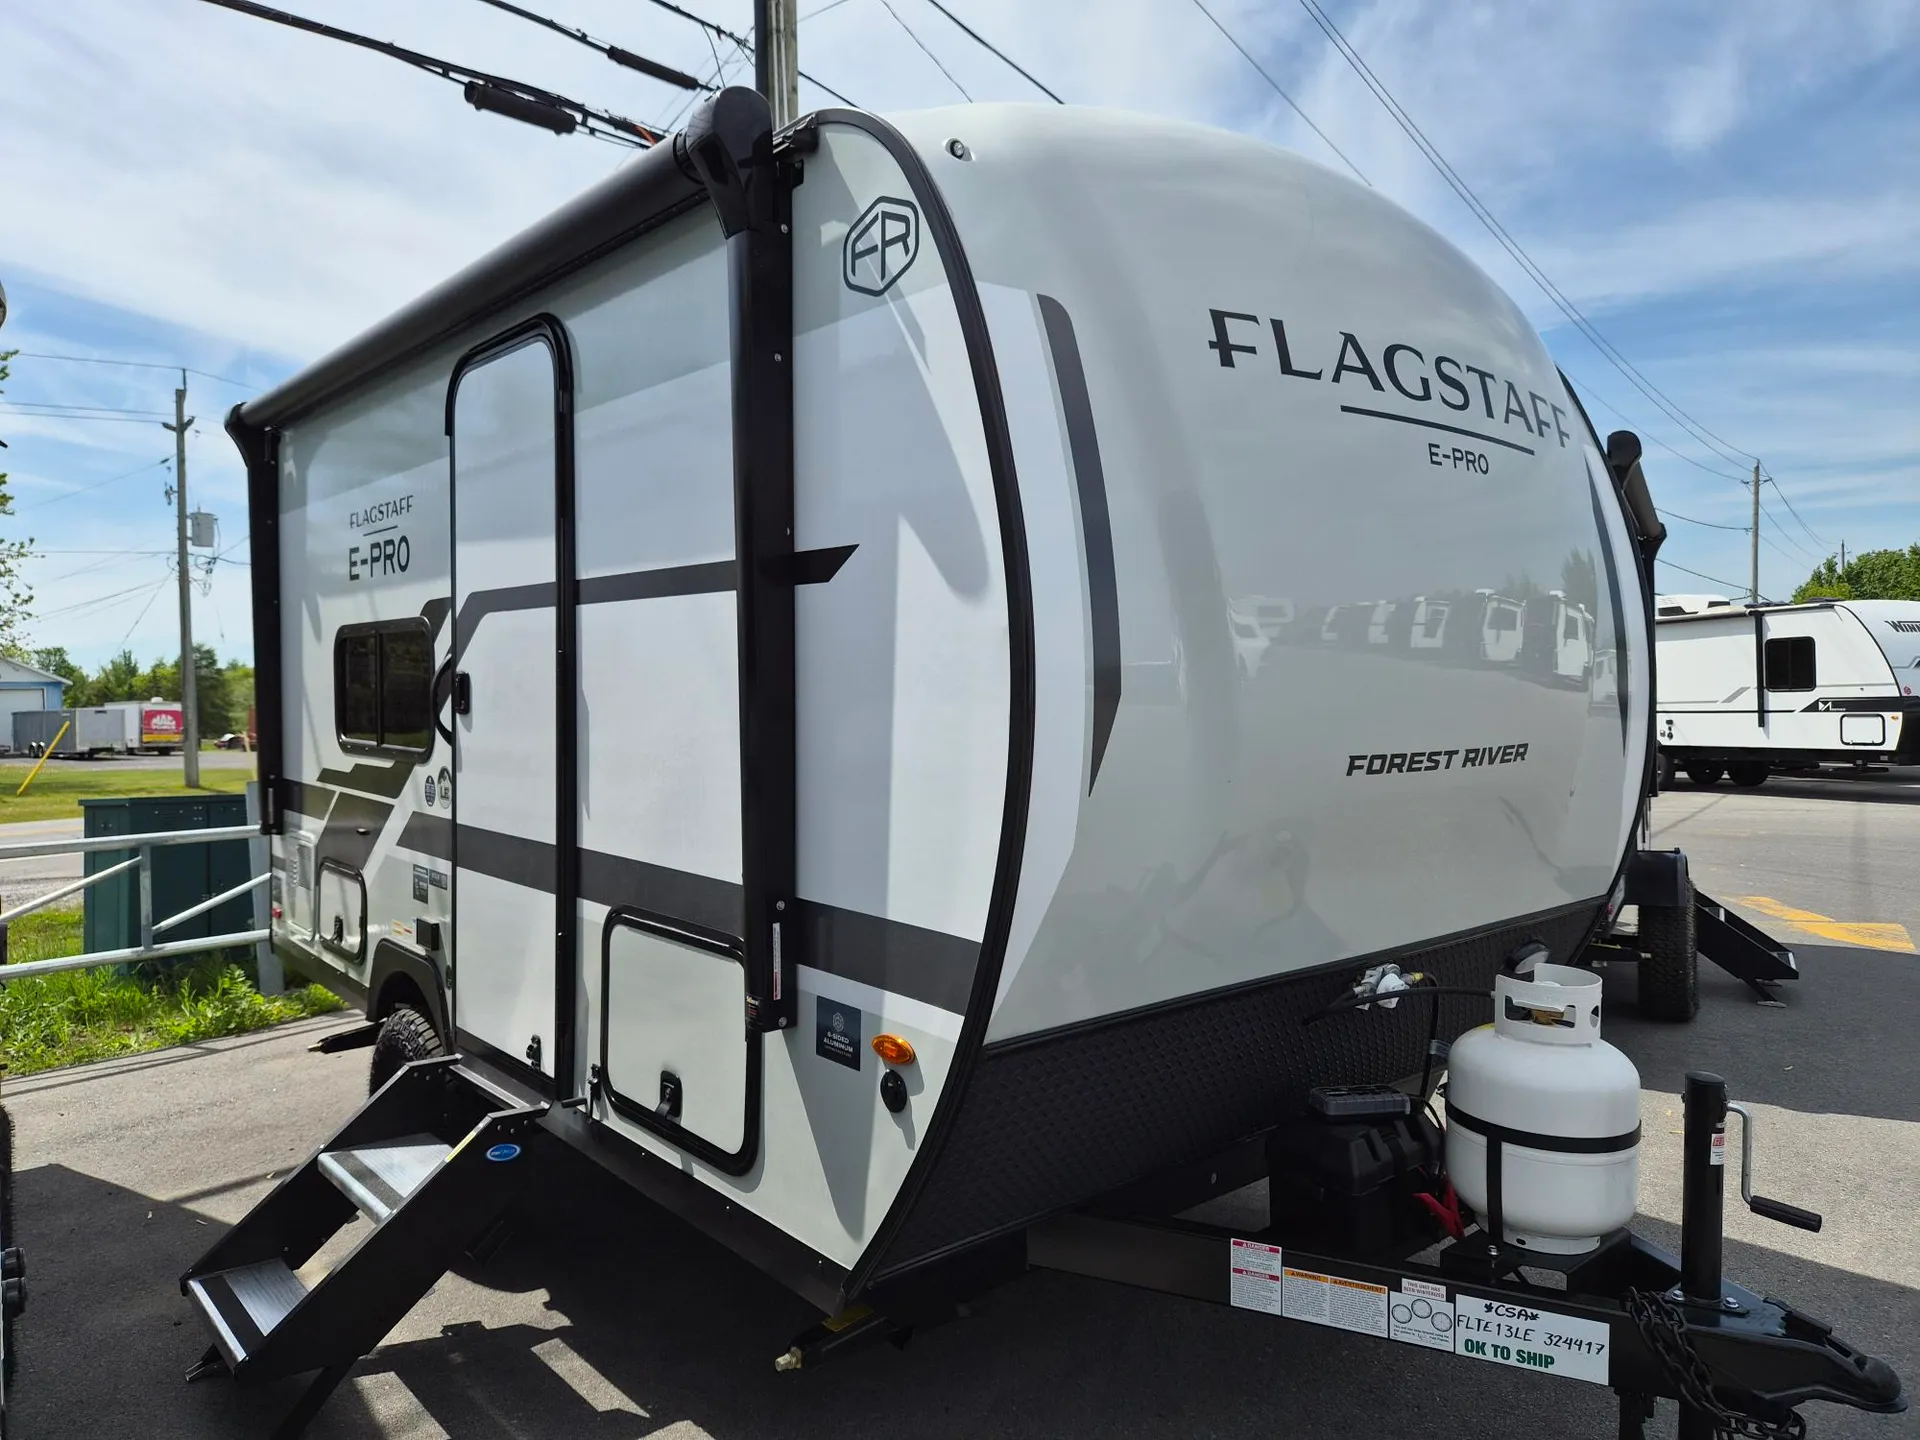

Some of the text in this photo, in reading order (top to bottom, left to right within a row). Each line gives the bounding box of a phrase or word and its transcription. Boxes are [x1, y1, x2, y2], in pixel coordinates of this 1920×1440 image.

[1208, 308, 1570, 448] FLAGSTAFF
[1428, 442, 1490, 475] E-PRO
[349, 494, 414, 529] FLAGSTAFF
[349, 535, 411, 582] E-PRO
[1346, 743, 1529, 776] FOREST RIVER
[823, 1037, 853, 1052] ALUMINUM
[1296, 1271, 1321, 1282] WARNING
[1464, 1338, 1555, 1369] OK TO SHIP
[1543, 1332, 1605, 1356] 324417
